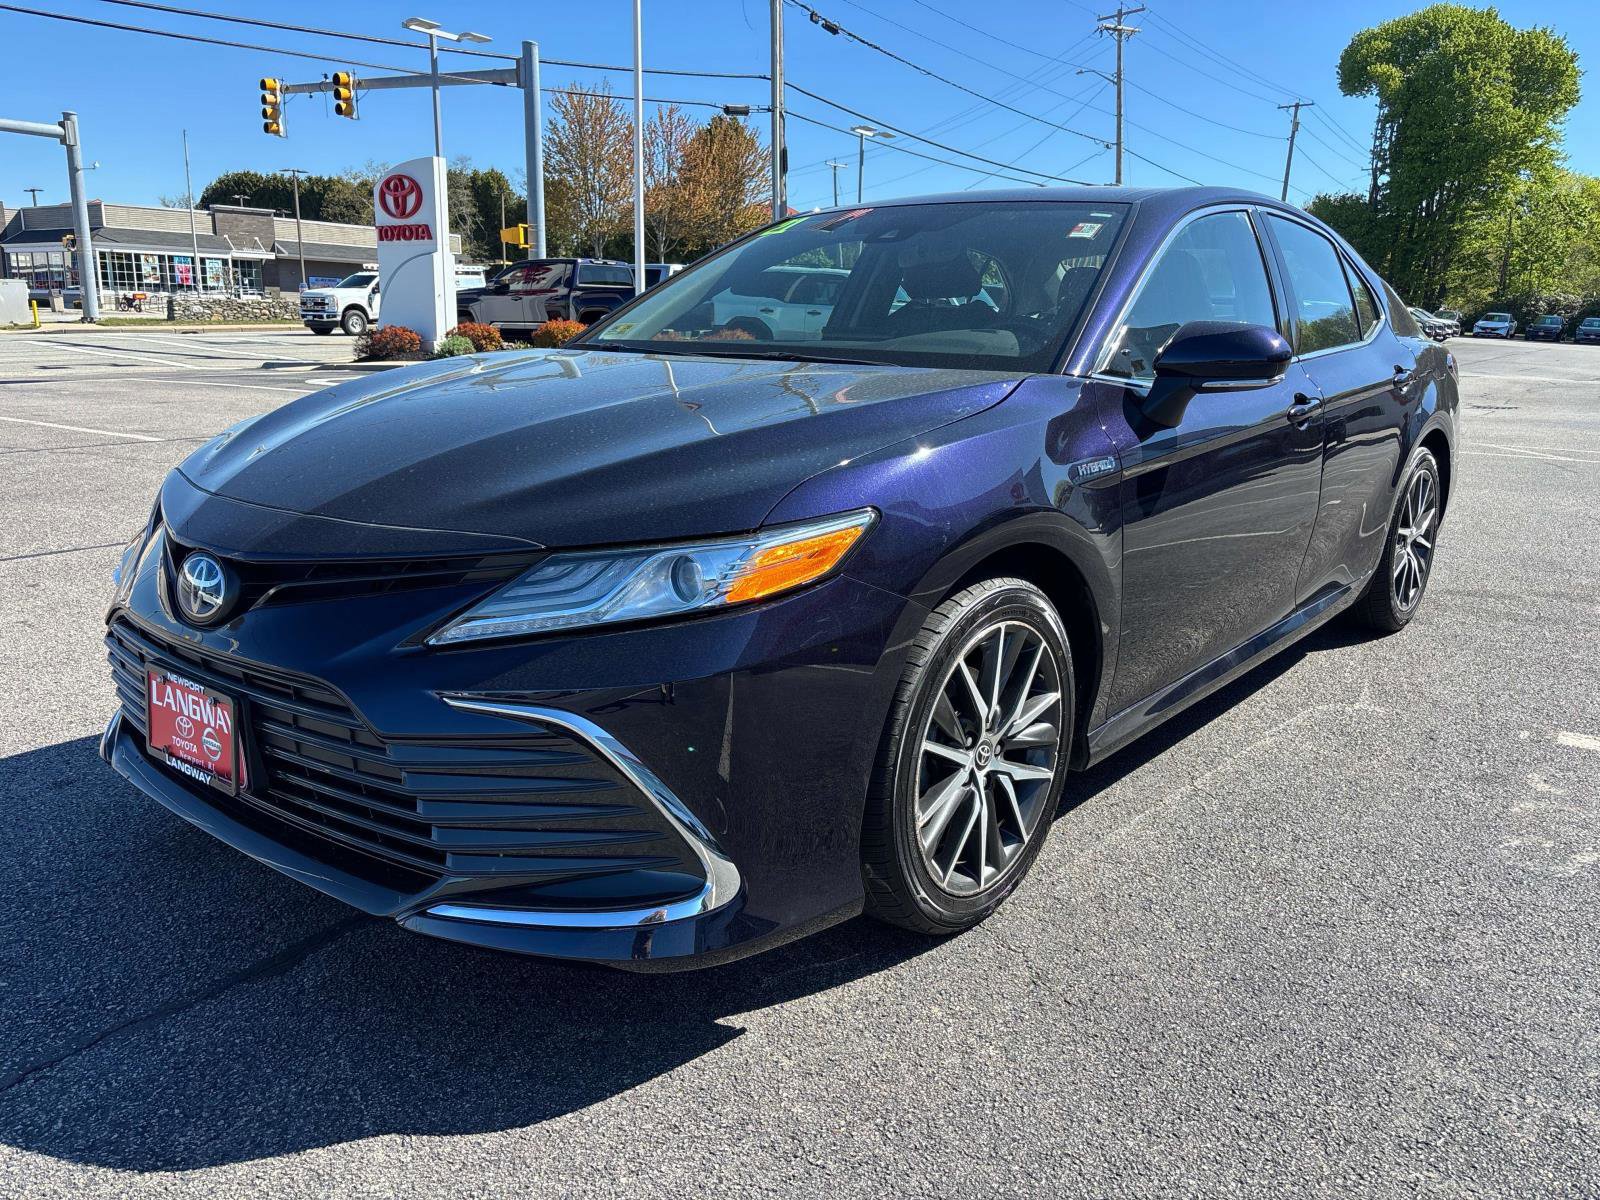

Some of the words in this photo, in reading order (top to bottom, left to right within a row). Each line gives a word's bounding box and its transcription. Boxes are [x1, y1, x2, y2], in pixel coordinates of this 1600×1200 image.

[376, 224, 433, 242] TOYOTA
[1077, 457, 1115, 476] HYBRID
[167, 672, 205, 694] NEWPORT
[172, 735, 198, 754] TOYOTA
[165, 753, 212, 785] LANGWAY
